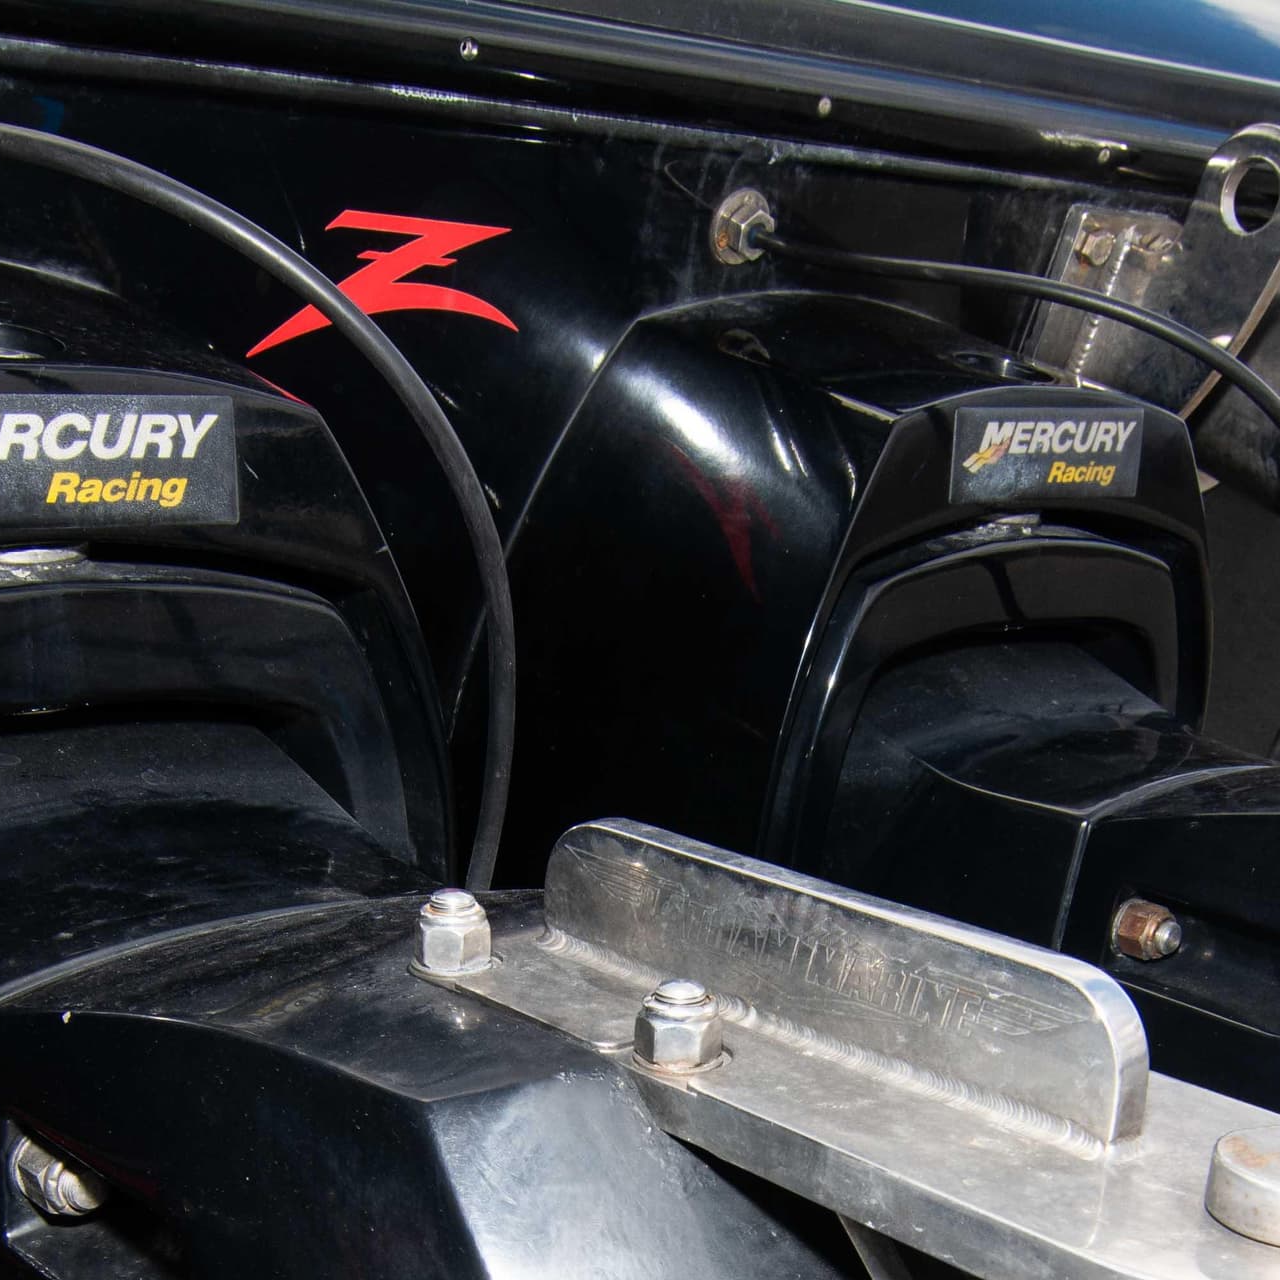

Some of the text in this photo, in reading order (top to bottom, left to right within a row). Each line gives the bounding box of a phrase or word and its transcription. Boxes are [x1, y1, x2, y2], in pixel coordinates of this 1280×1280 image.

[978, 421, 1137, 454] MERCURY
[46, 471, 187, 507] Racing
[1047, 460, 1116, 486] Racing
